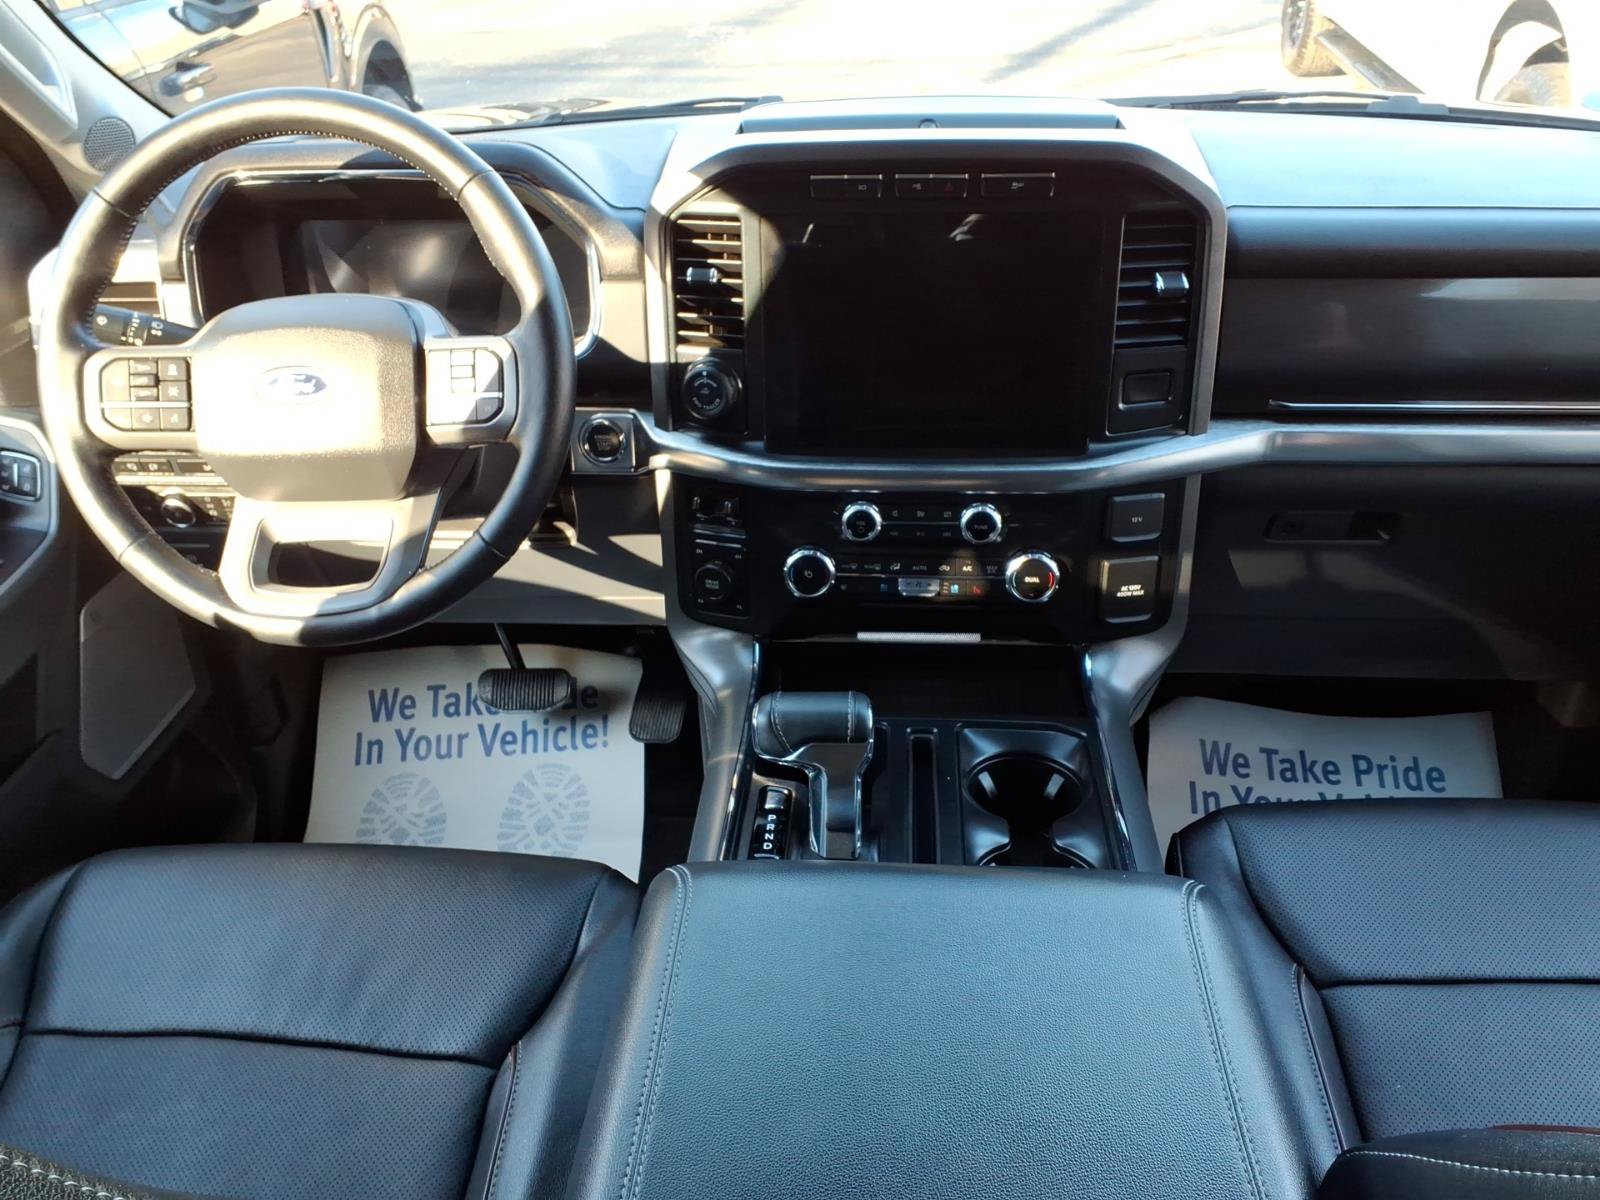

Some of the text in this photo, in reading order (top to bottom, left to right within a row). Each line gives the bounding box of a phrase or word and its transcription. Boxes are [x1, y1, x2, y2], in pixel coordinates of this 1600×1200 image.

[368, 682, 502, 723] We Tak
[354, 714, 610, 766] In Your Vehicle!
[1199, 738, 1447, 793] We Take Pride
[1189, 781, 1221, 815] In
[766, 823, 775, 831] R
[767, 814, 777, 822] P
[763, 842, 773, 850] D
